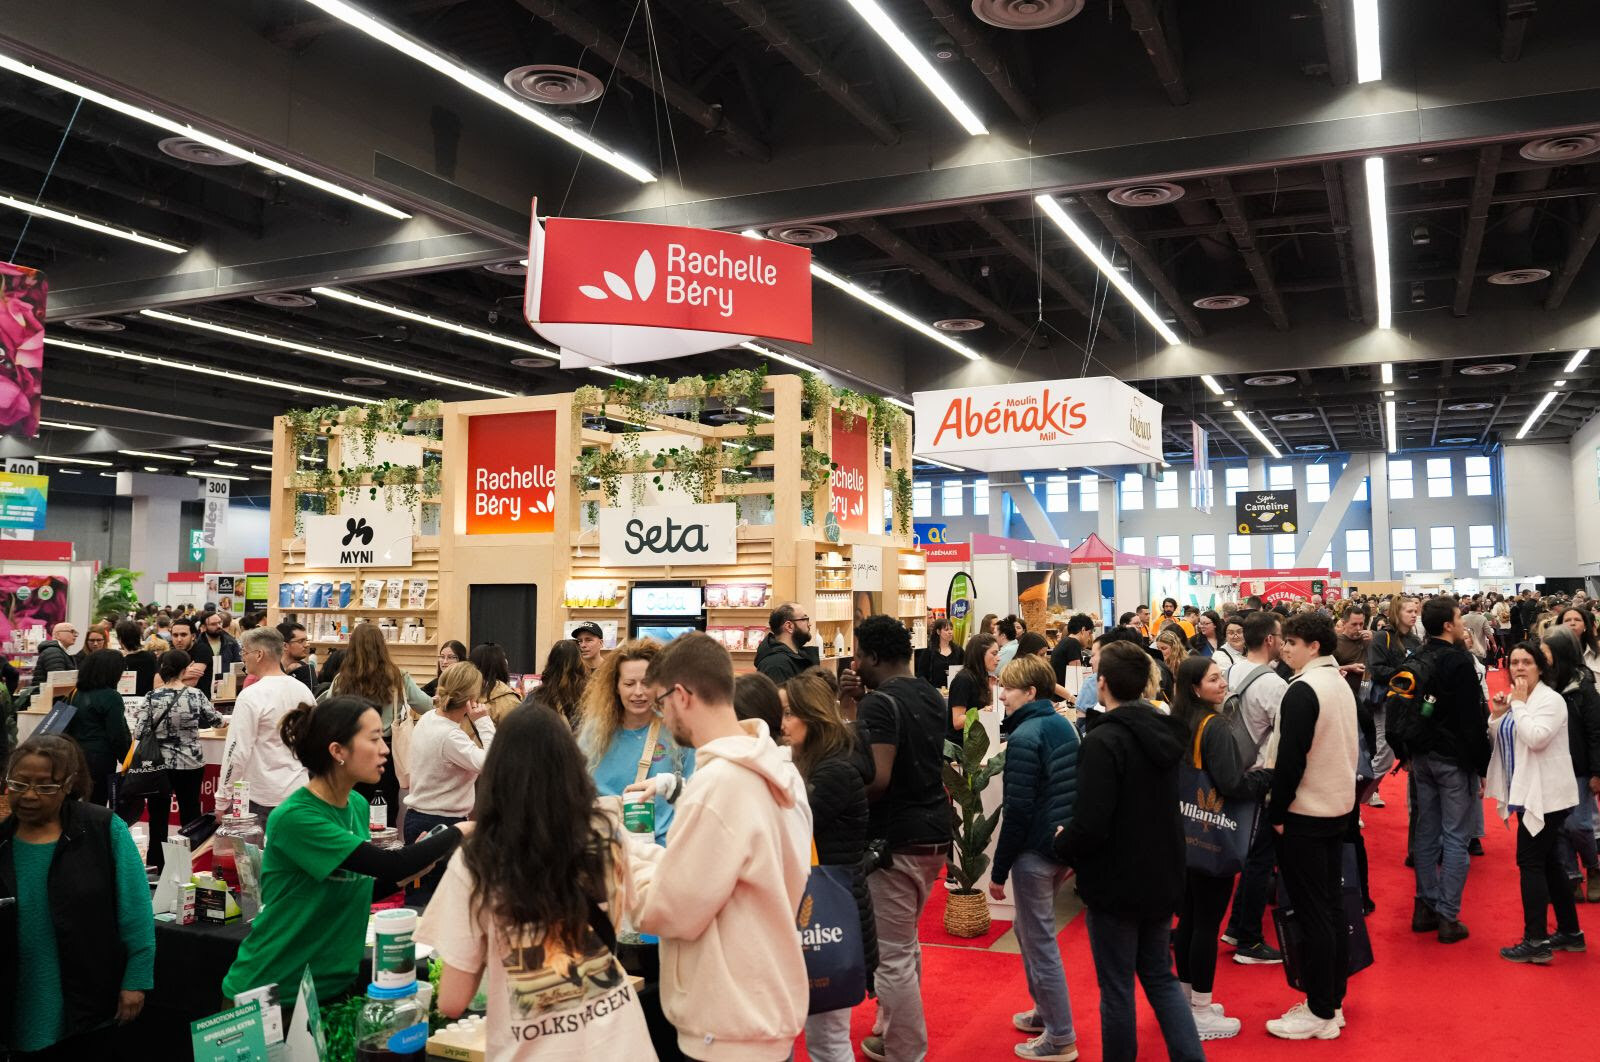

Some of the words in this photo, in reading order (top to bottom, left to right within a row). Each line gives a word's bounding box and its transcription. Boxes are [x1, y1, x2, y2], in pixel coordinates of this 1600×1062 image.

[667, 243, 777, 286] Rachelle
[1006, 396, 1037, 407] Moulin
[933, 389, 1087, 446] Abénakis
[1039, 432, 1057, 441] Mill
[209, 482, 227, 494] 300
[476, 465, 556, 490] Rachelle
[831, 466, 864, 492] achelle
[204, 501, 218, 547] Allée
[625, 517, 708, 554] Seta
[340, 550, 374, 564] MYNI
[196, 1013, 235, 1030] PROMOTION
[235, 1004, 253, 1017] SALON
[237, 1019, 256, 1030] EXTRA
